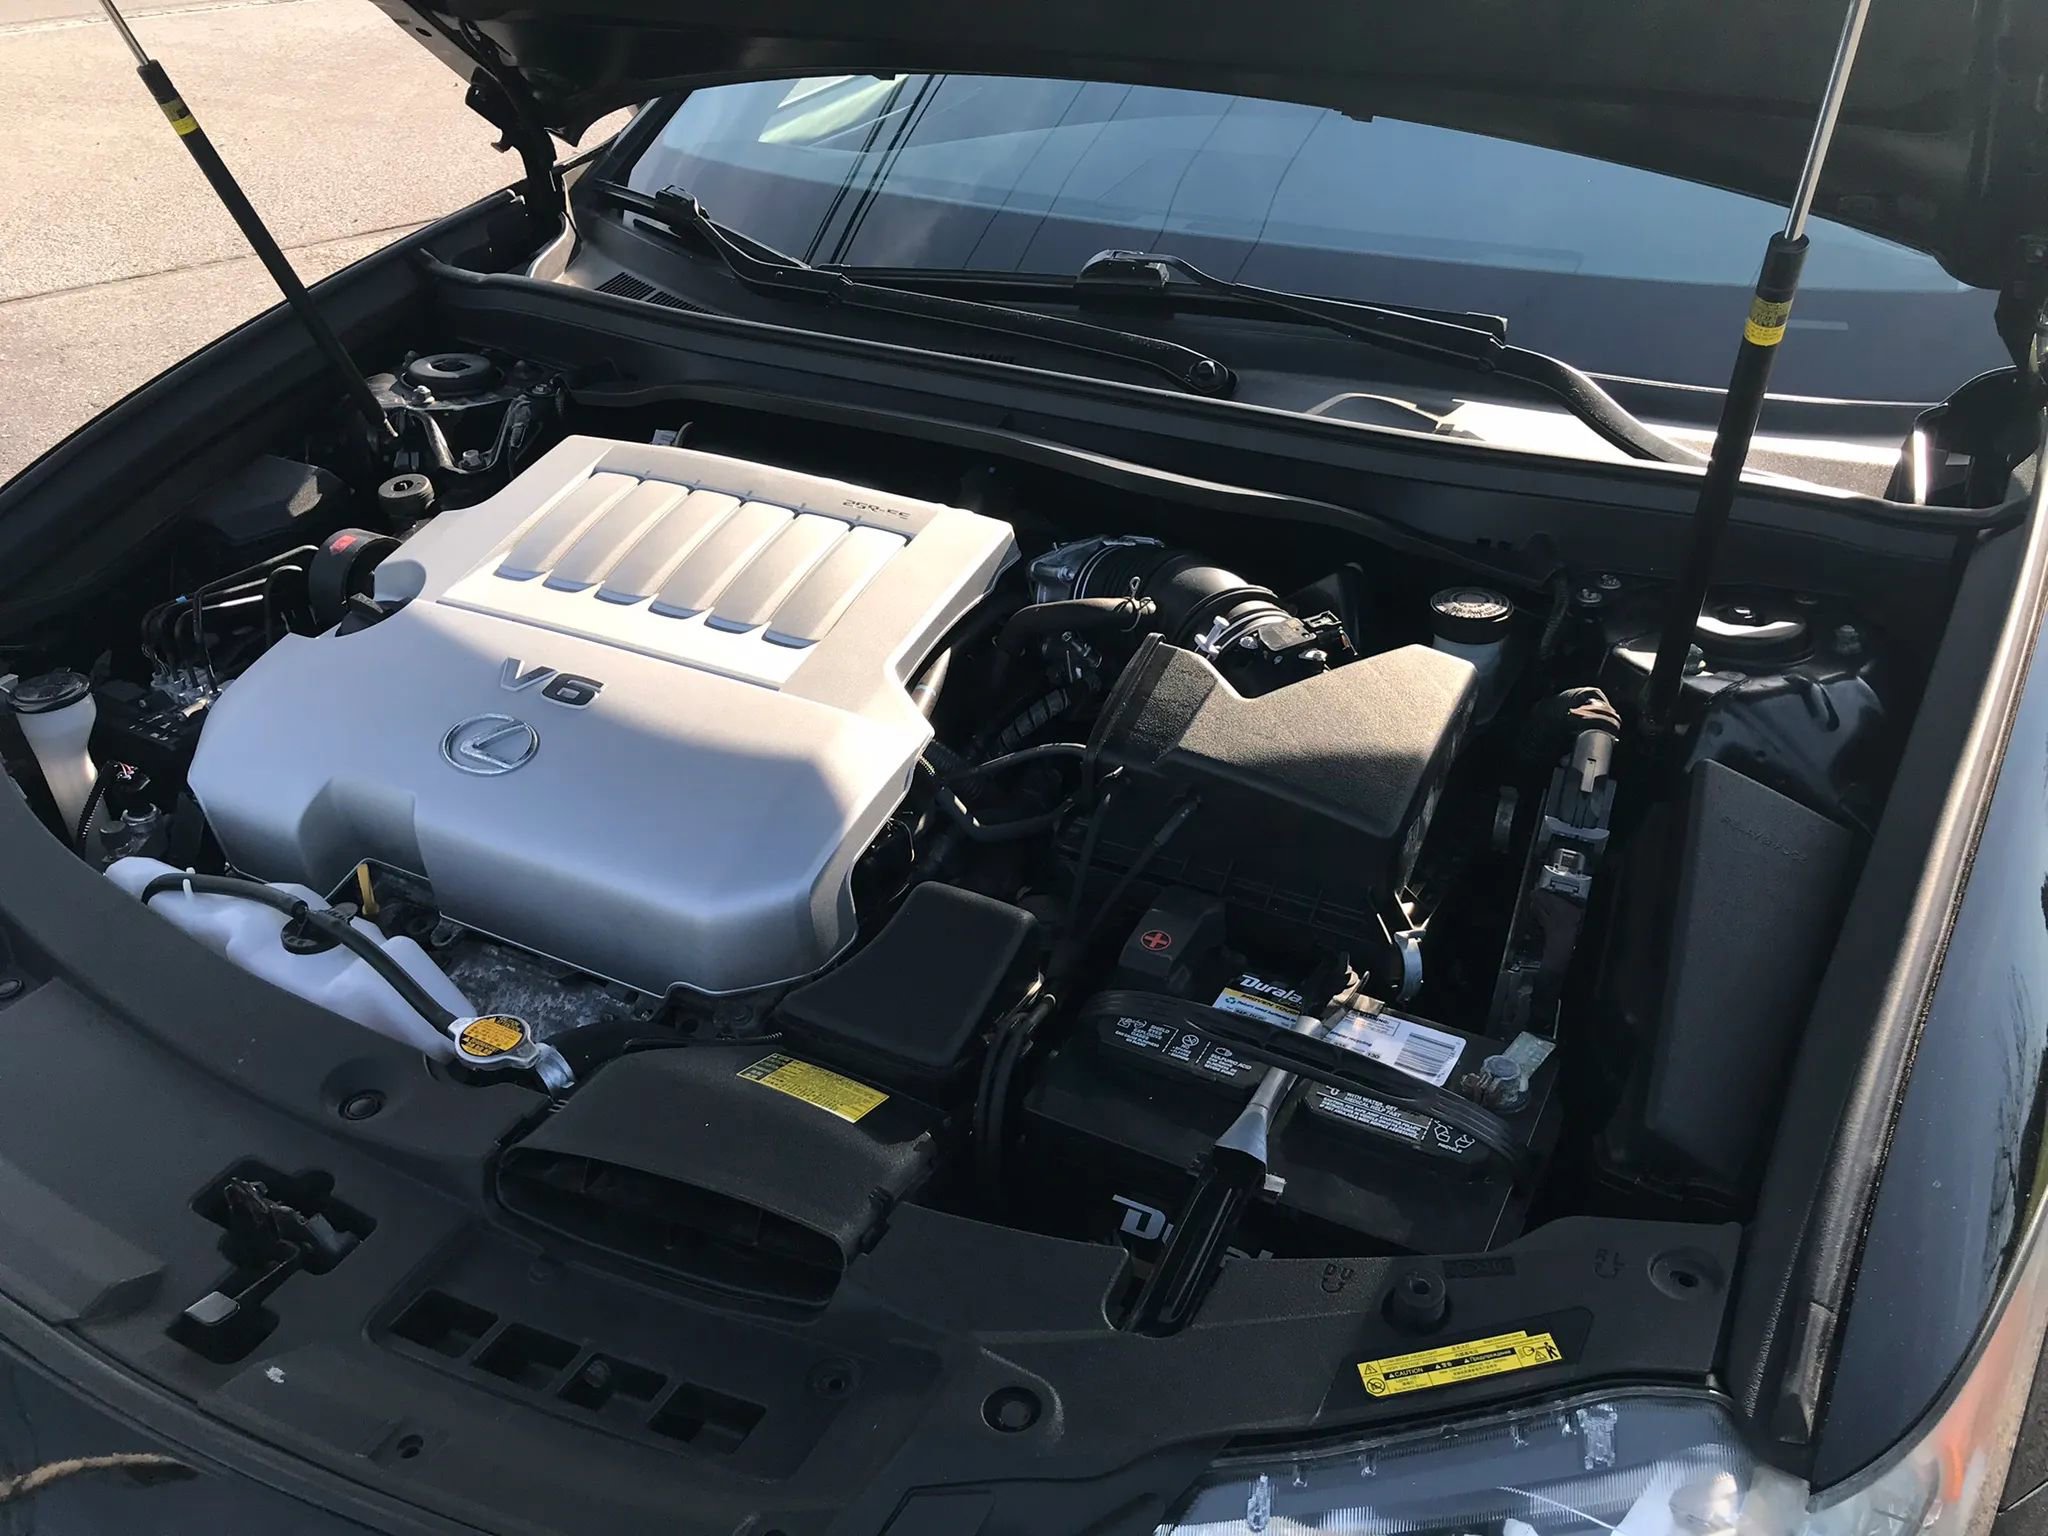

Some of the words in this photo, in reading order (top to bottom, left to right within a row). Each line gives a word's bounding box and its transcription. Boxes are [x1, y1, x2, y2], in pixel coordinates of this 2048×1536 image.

[500, 656, 608, 710] V6
[1240, 974, 1303, 1005] Durala
[1394, 1367, 1424, 1378] CAUTION
